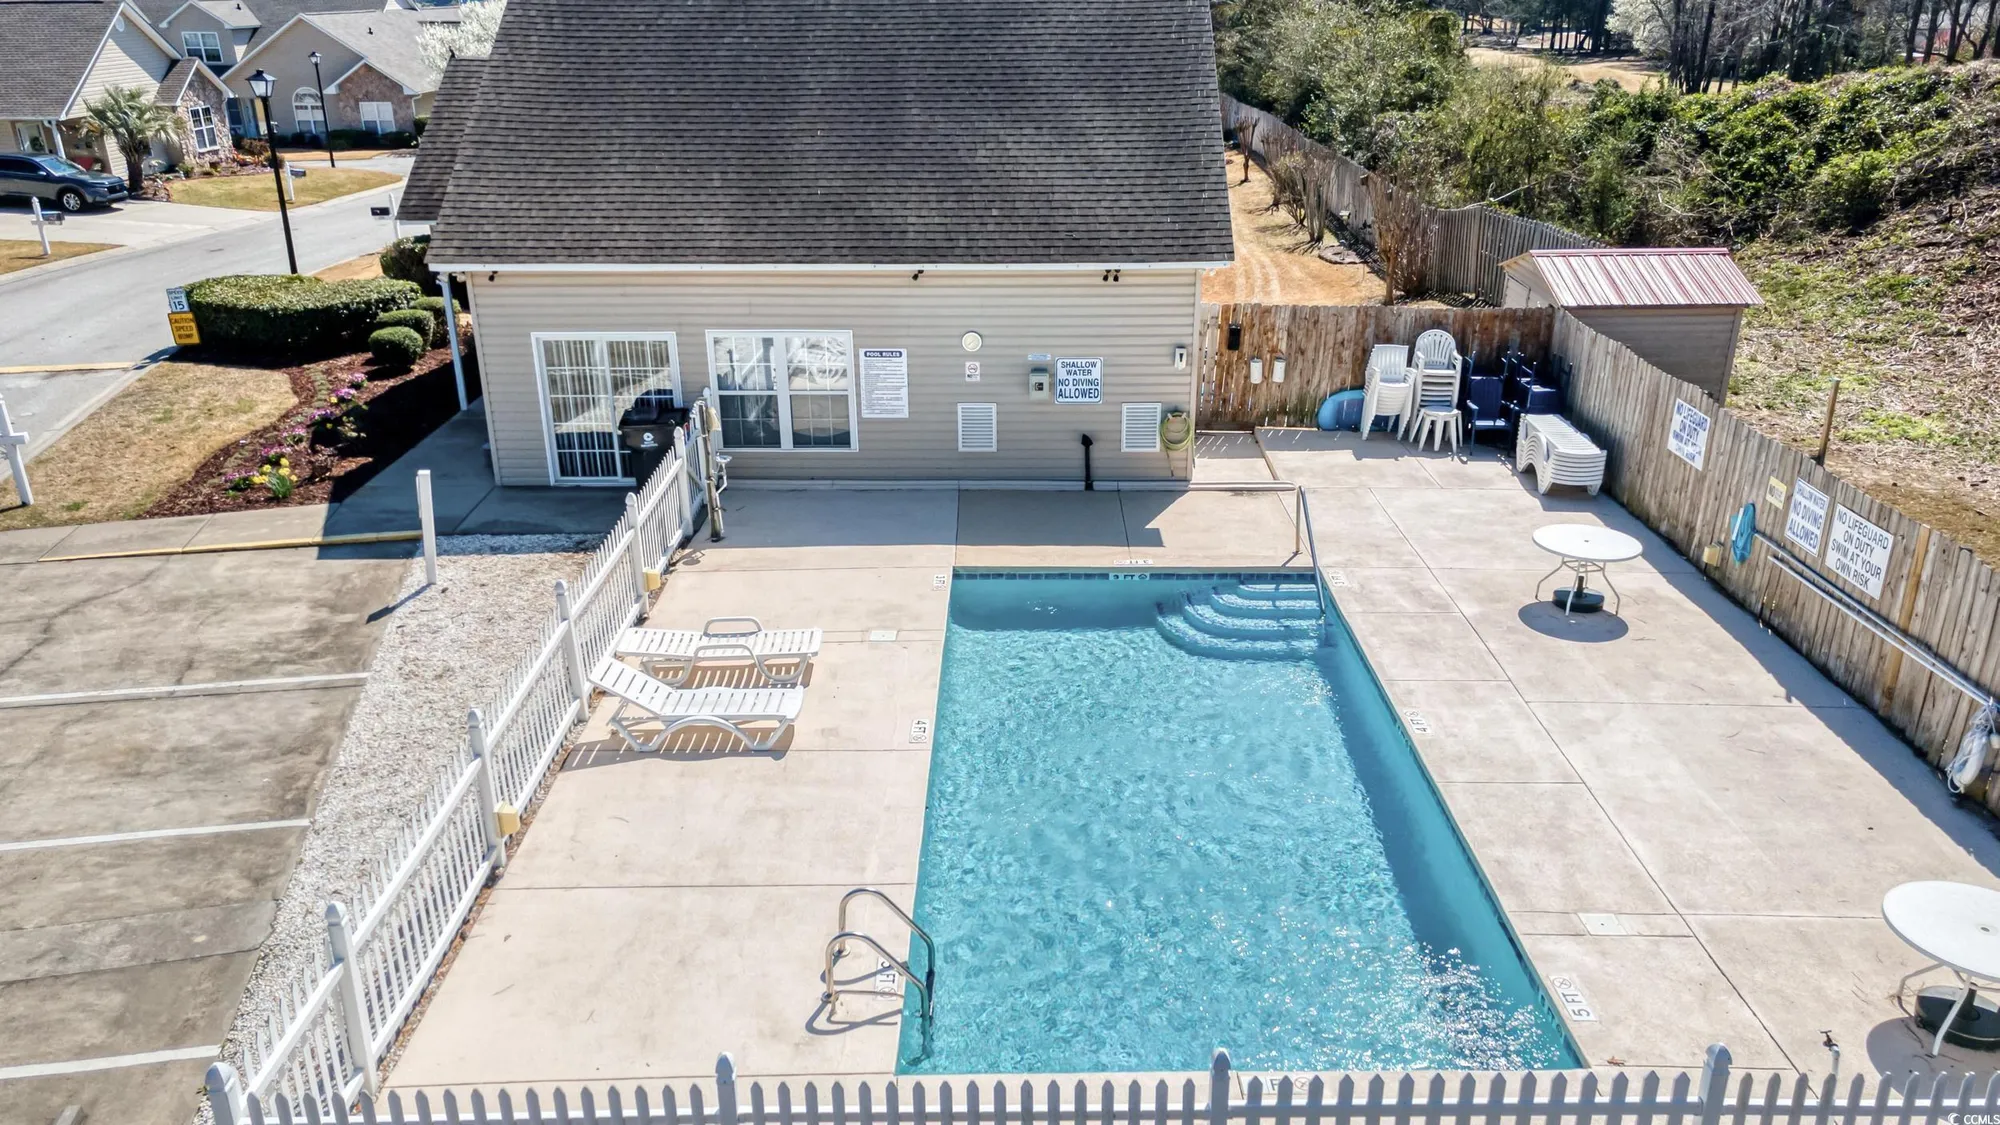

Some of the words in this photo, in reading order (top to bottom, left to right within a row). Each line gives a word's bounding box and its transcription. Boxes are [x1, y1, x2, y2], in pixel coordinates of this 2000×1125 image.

[173, 301, 185, 310] 15
[1061, 361, 1097, 369] SHALLOW
[1058, 378, 1070, 387] NO
[1072, 378, 1099, 387] DIVING
[1057, 388, 1099, 399] ALLOWED
[1676, 401, 1683, 416] NO
[1683, 405, 1708, 432] LIFEGUARD
[1792, 498, 1802, 516] NO
[1802, 504, 1822, 530] DIVING
[1788, 518, 1819, 550] ALLOWED
[1837, 508, 1847, 525] NO
[1848, 515, 1889, 550] LIFEGUARD
[1843, 530, 1854, 547] ON
[1854, 537, 1875, 558] DUTY
[1831, 538, 1849, 559] SWIM
[1849, 551, 1860, 566] AT
[1861, 557, 1882, 580] YOUR
[1835, 558, 1852, 578] OWN
[1852, 569, 1870, 590] RISK
[880, 973, 896, 984] FT
[1561, 992, 1583, 1003] FT
[1571, 1008, 1590, 1017] 5
